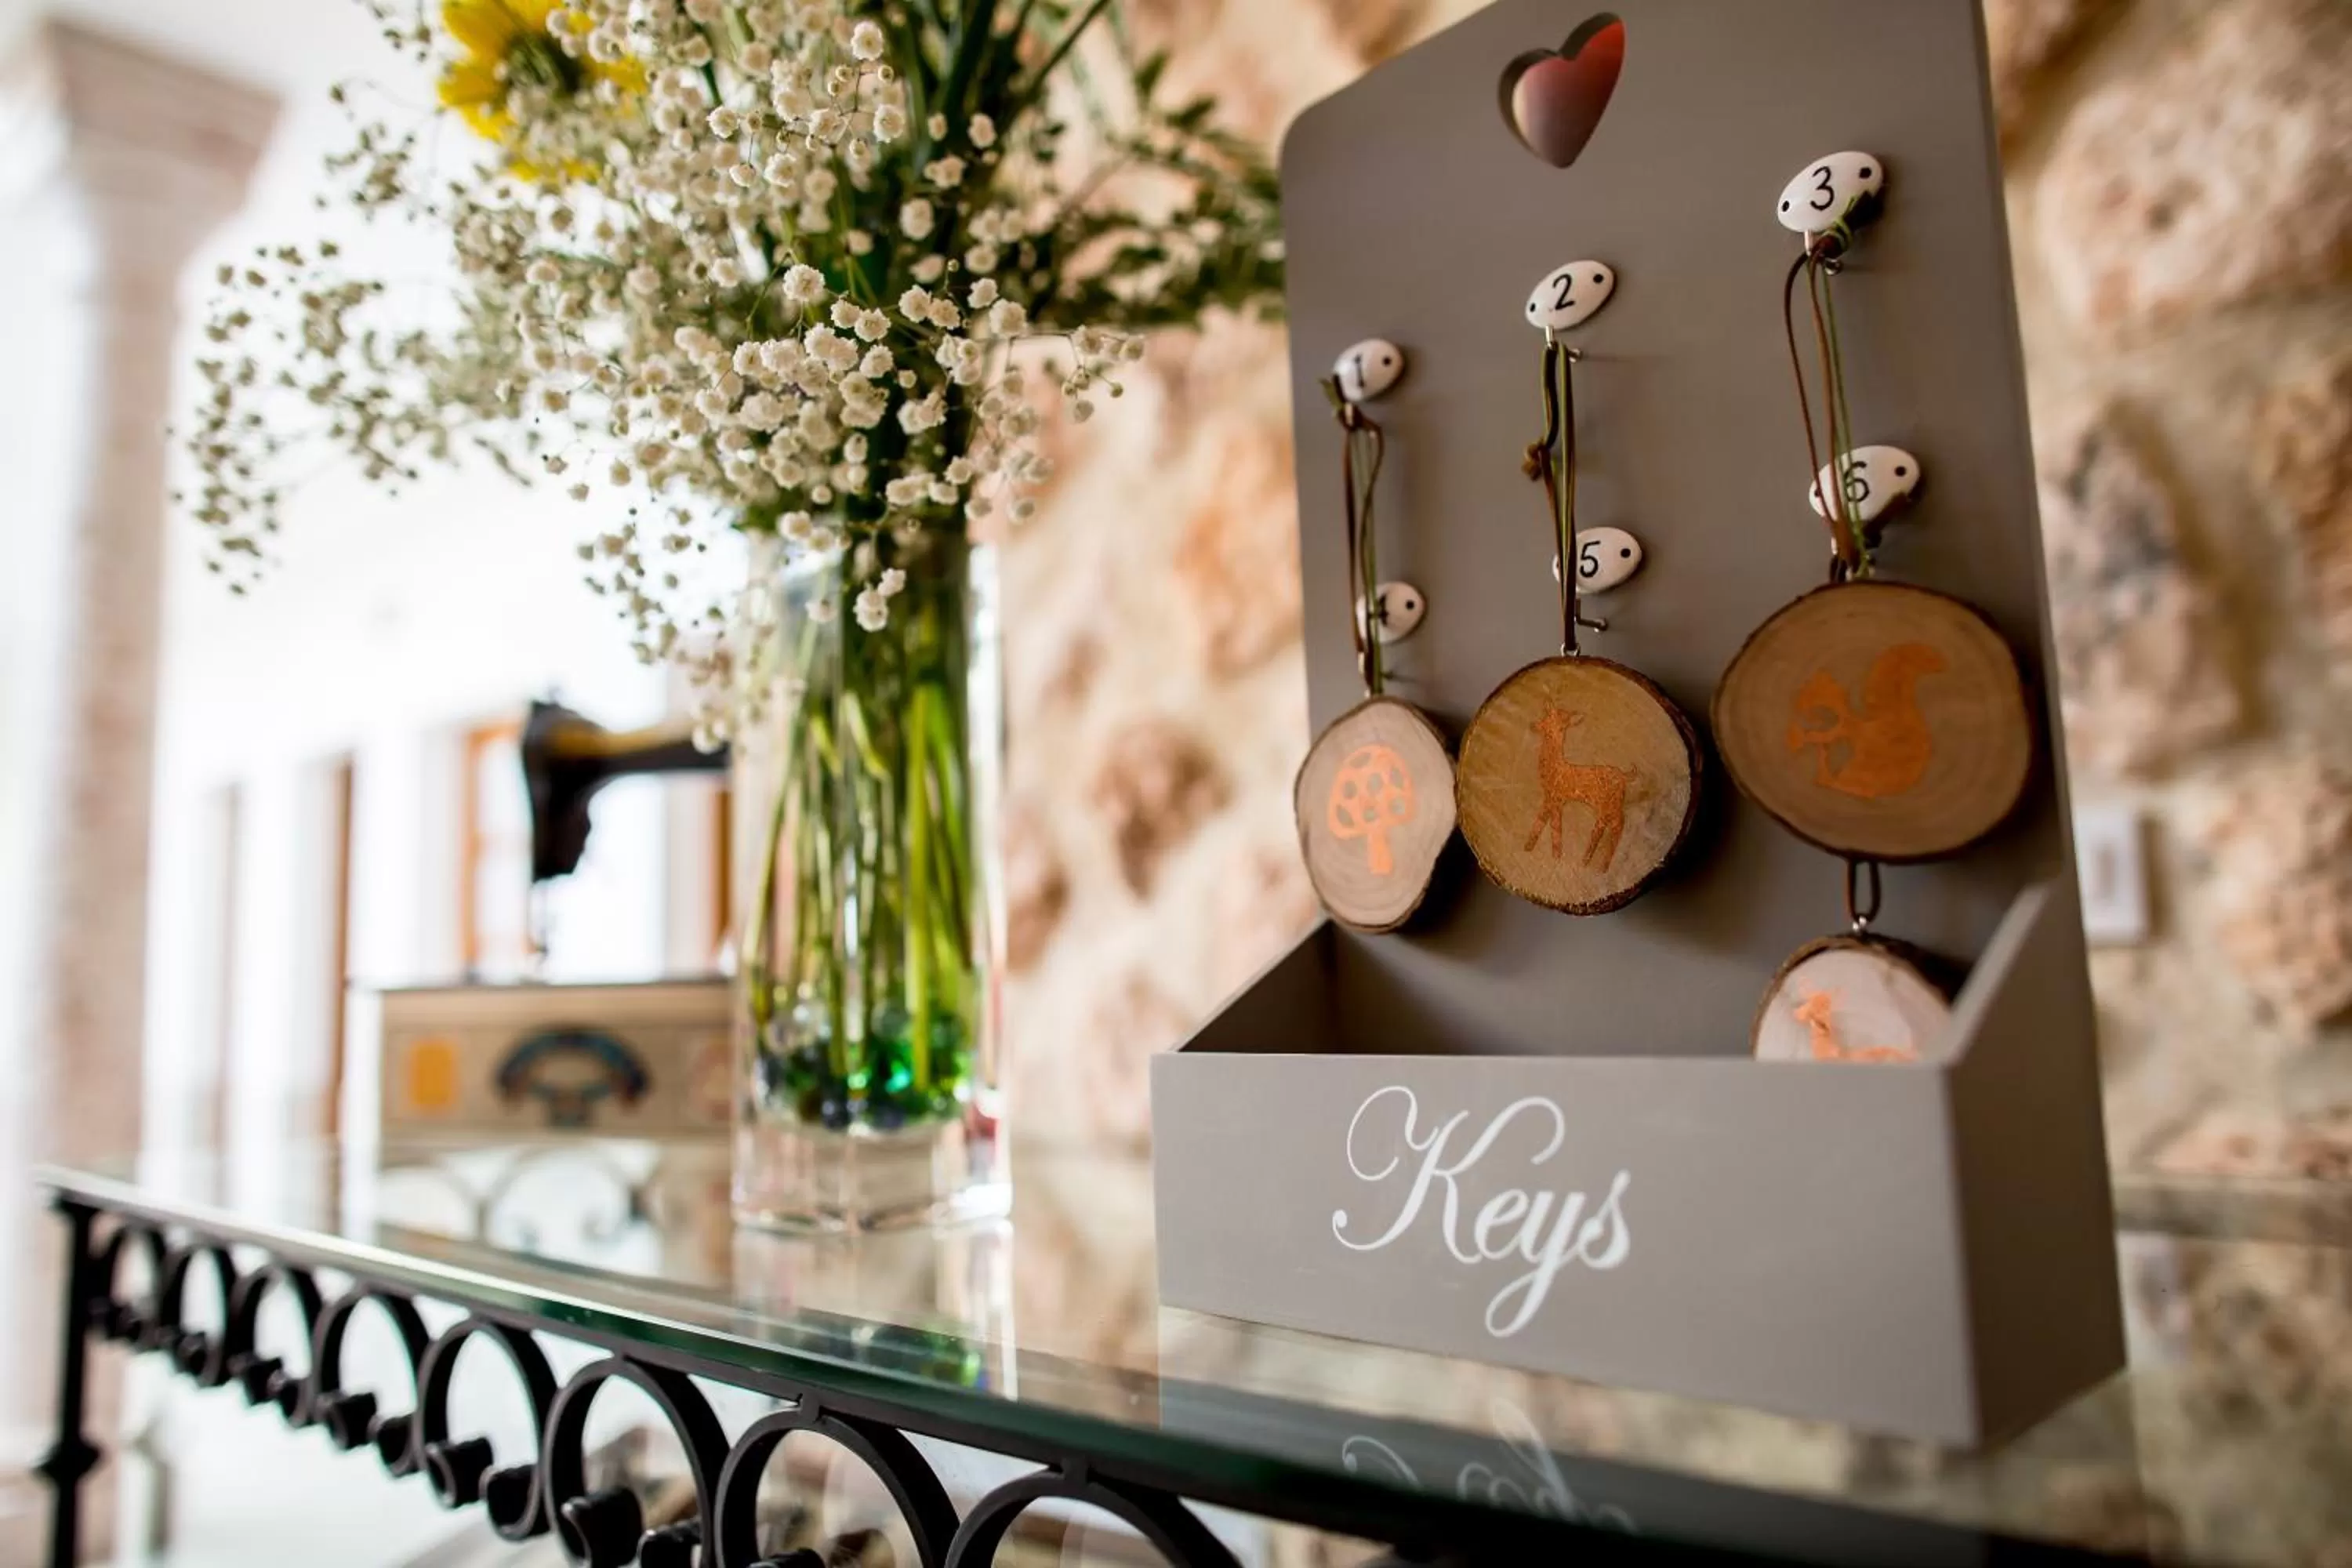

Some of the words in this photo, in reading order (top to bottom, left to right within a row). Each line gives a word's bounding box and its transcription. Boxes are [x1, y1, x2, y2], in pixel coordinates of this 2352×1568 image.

[1809, 165, 1836, 212] 3
[1552, 273, 1576, 311] 2
[1353, 353, 1366, 389] 1
[1843, 460, 1870, 503] 6
[1579, 539, 1601, 579] 5
[1332, 1084, 1632, 1338] Keys
